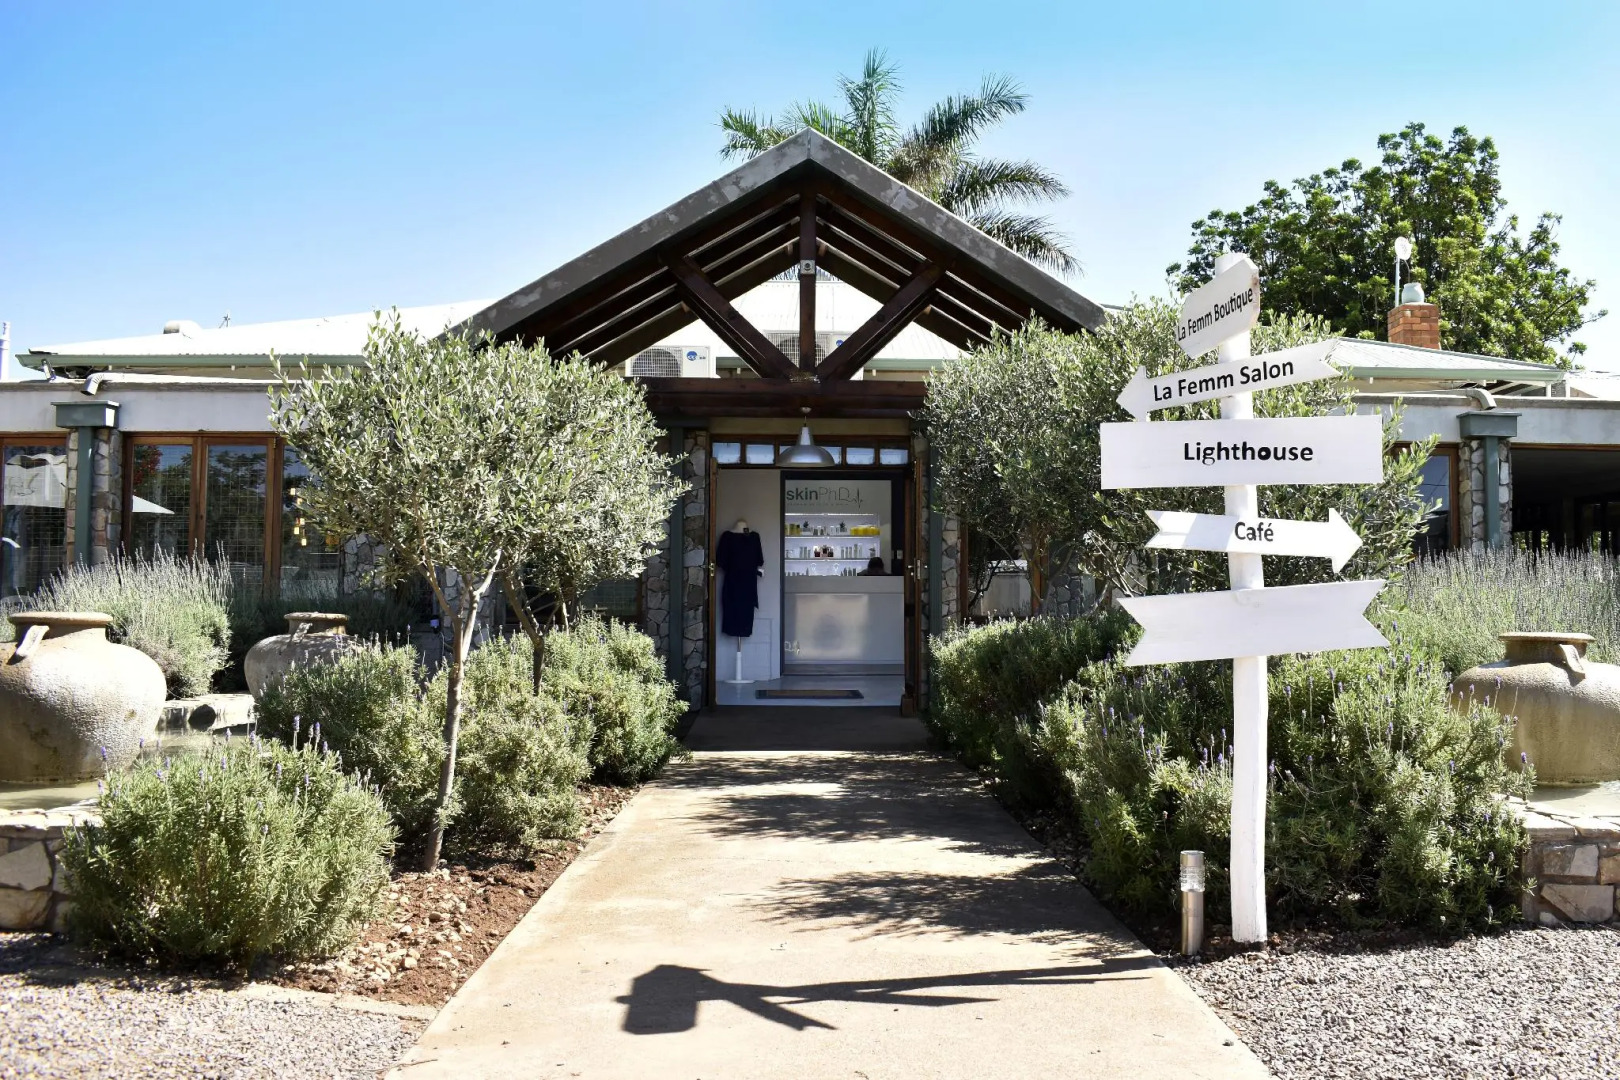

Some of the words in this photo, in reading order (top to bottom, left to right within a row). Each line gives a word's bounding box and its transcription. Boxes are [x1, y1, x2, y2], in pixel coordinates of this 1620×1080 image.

[1177, 325, 1186, 342] La
[1187, 311, 1213, 336] Femm
[1213, 287, 1253, 321] Boutique
[1153, 384, 1172, 402] La
[1178, 372, 1234, 397] Femm
[1240, 361, 1294, 385] Salon
[1184, 441, 1314, 466] Lighthouse
[1234, 521, 1274, 542] Café
